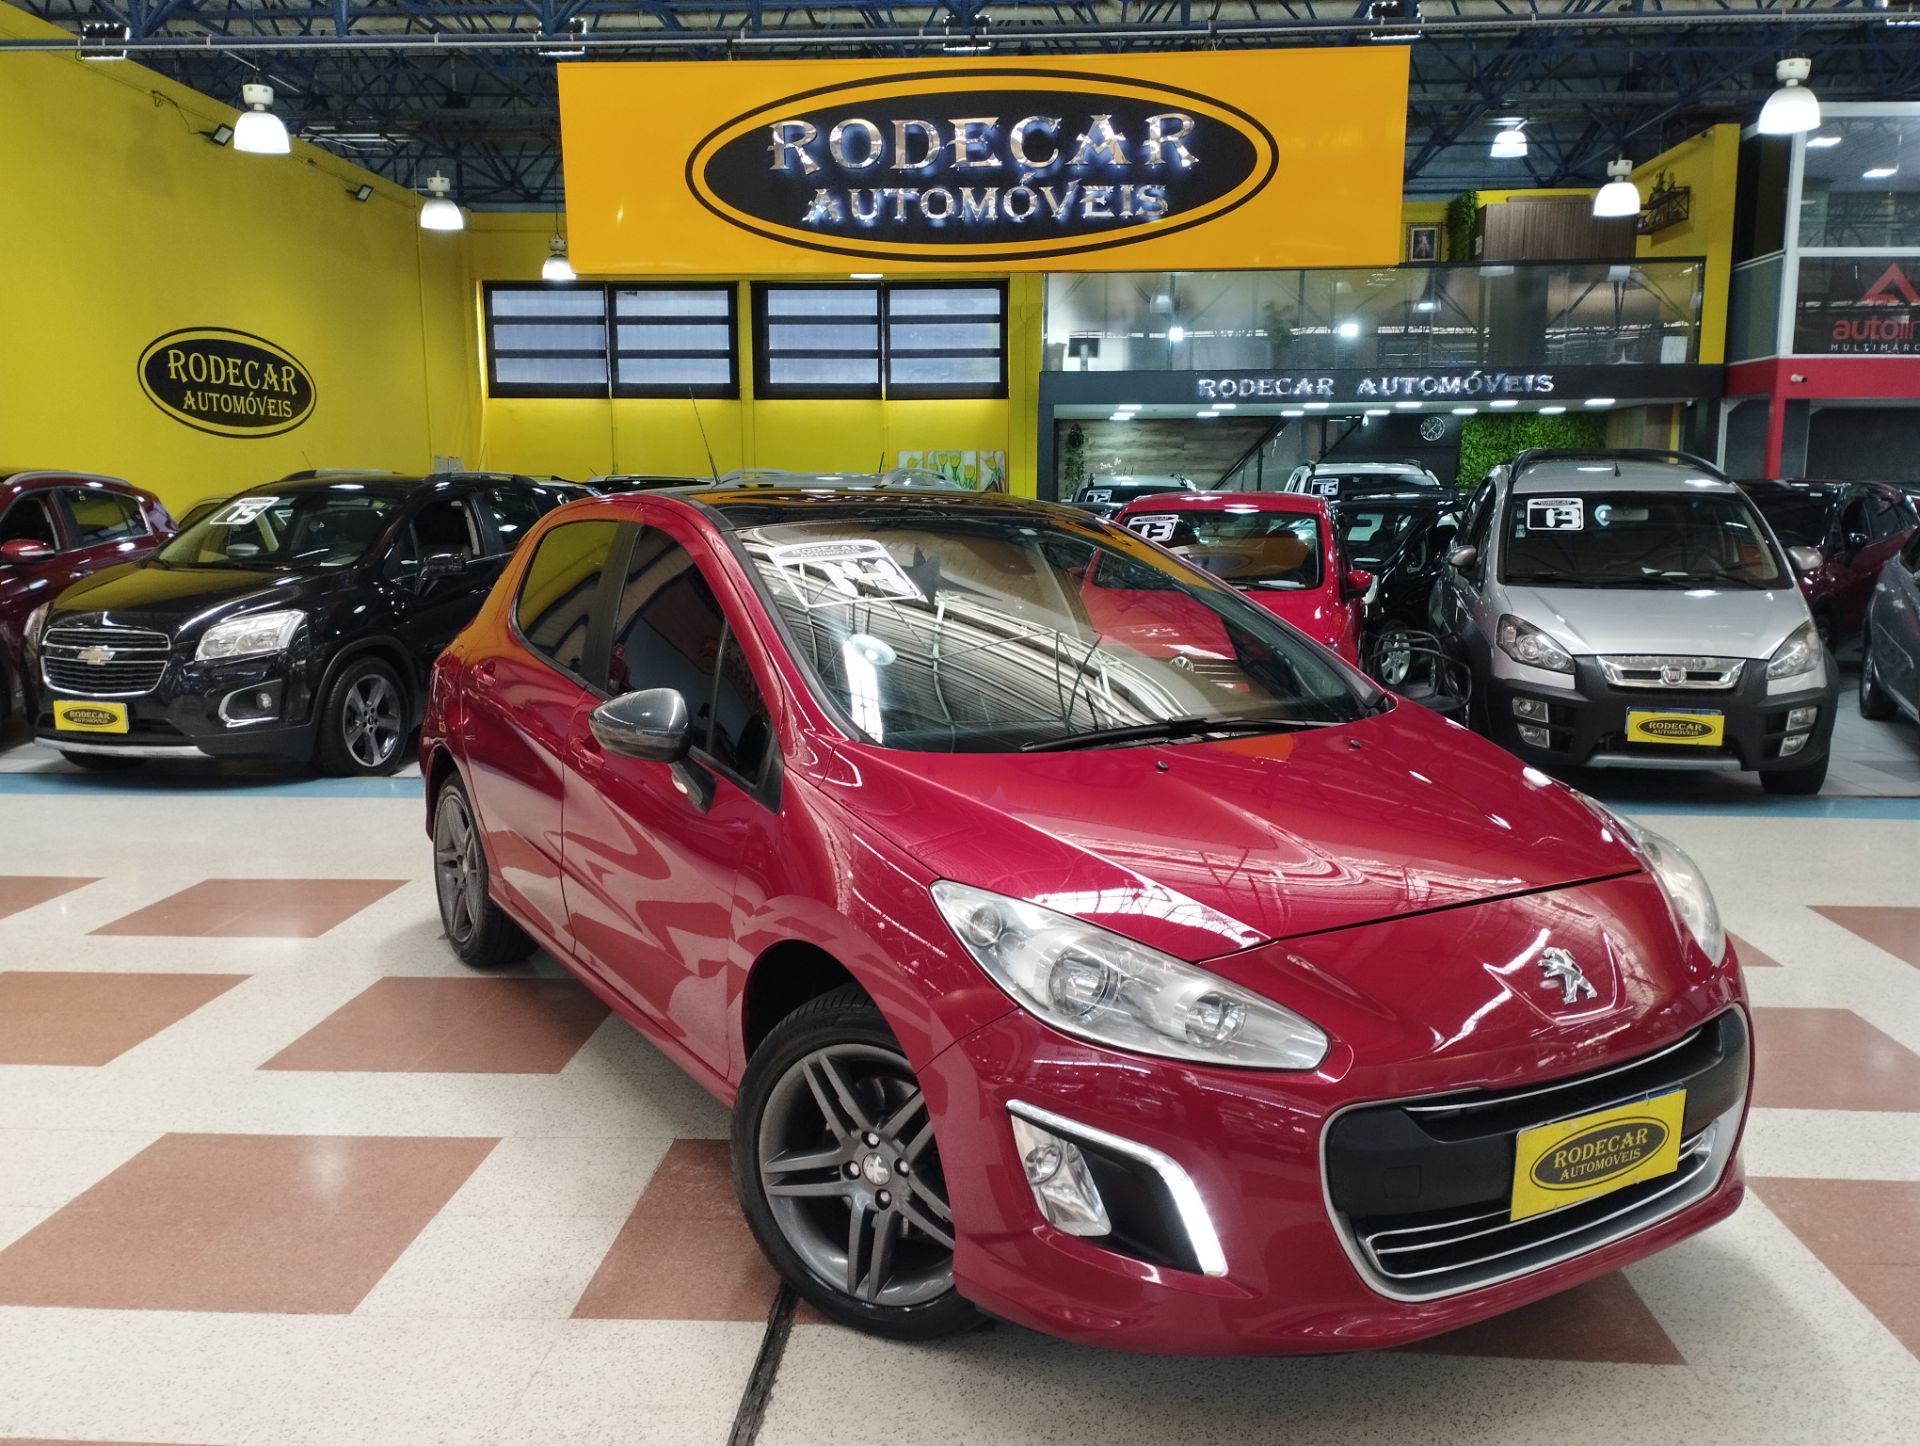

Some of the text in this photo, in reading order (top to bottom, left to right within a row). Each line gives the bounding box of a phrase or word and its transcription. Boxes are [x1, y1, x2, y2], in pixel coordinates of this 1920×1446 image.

[766, 113, 1200, 175] RODECAR
[802, 172, 1169, 222] AUTOMÓVEIS
[168, 349, 298, 395] RODECAR
[1198, 371, 1554, 398] RODECAR AUTOMÓVEIS
[183, 390, 292, 418] AUTOMÓVEIS
[1320, 483, 1336, 494] 16
[227, 505, 265, 524] 15
[1546, 507, 1581, 528] 13
[1140, 522, 1173, 541] 13
[69, 711, 110, 719] RODECAR
[1649, 721, 1702, 732] RODECAR
[1553, 1128, 1648, 1168] RODECAR
[1560, 1148, 1641, 1181] AUTOMÓVEIS
